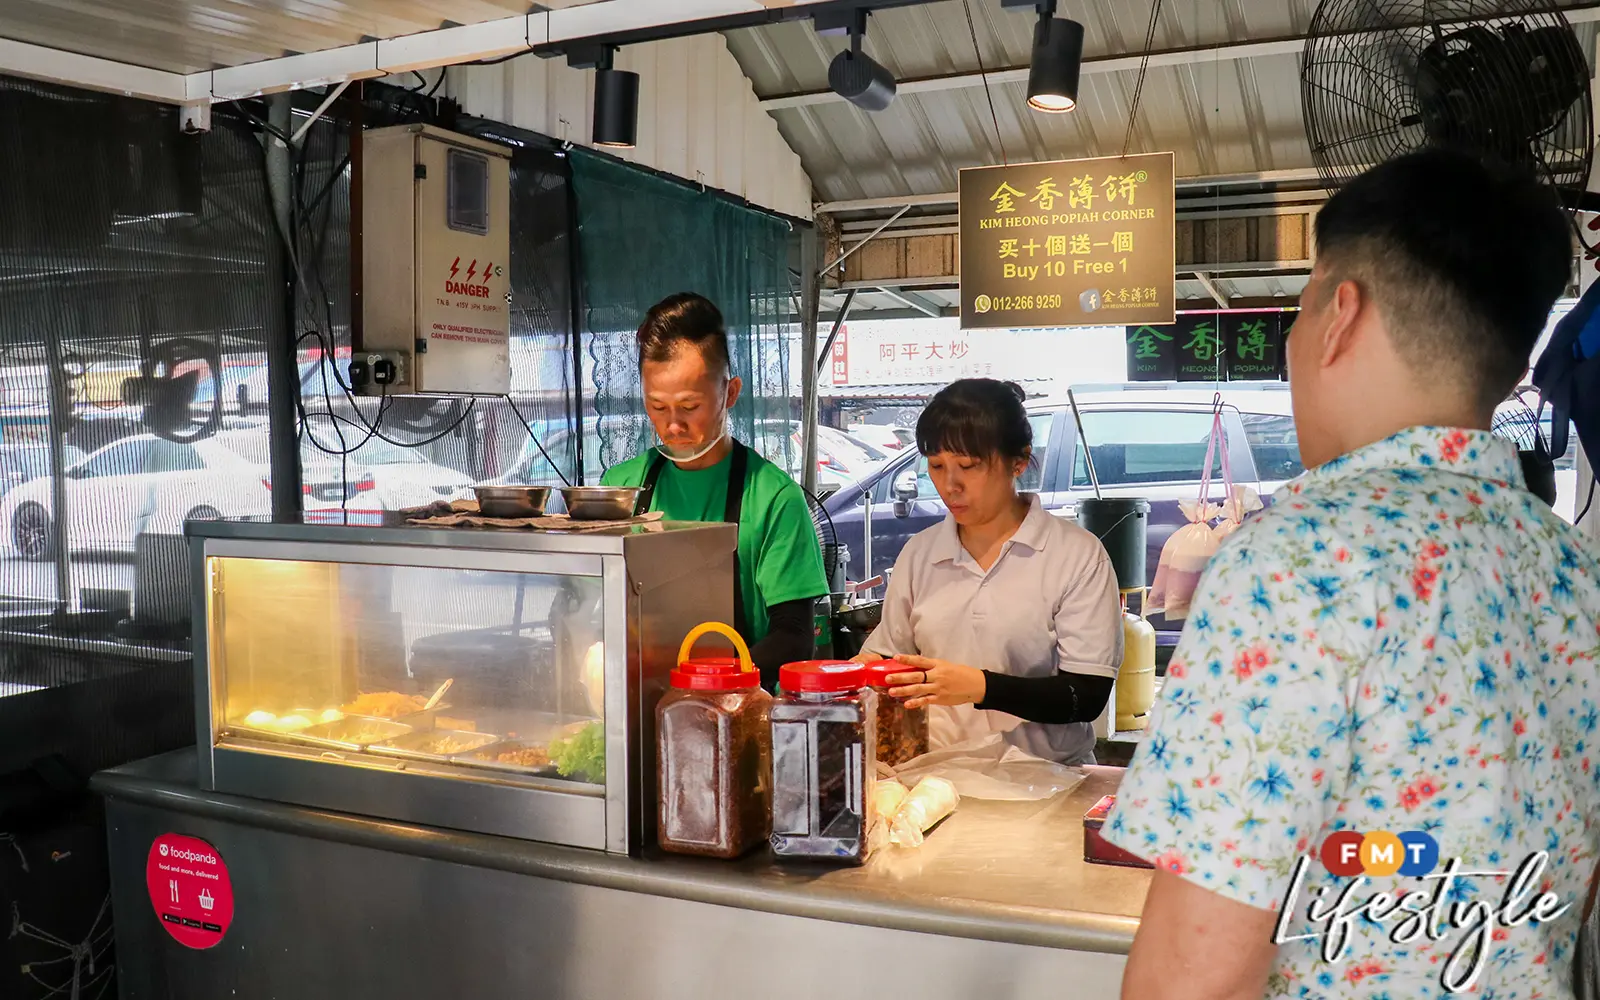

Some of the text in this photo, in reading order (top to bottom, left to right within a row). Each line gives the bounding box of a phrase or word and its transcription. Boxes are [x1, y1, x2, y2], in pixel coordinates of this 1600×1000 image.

[990, 172, 1138, 214] 金香薄餅
[980, 208, 1155, 230] KIM HEONG POPIAH CORNER
[999, 231, 1133, 259] 买十個送一個
[1003, 258, 1127, 281] Buy 10 Free 1
[445, 280, 489, 298] DANGER
[993, 294, 1061, 311] 012-266 9250
[443, 334, 464, 342] REMOVE
[447, 325, 473, 333] QUALIFIED
[879, 340, 970, 362] 阿平大炒
[1234, 364, 1275, 372] POPIAH
[170, 846, 217, 865] foodpanda
[159, 863, 170, 871] food
[180, 869, 195, 877] more,
[195, 870, 219, 881] delivered
